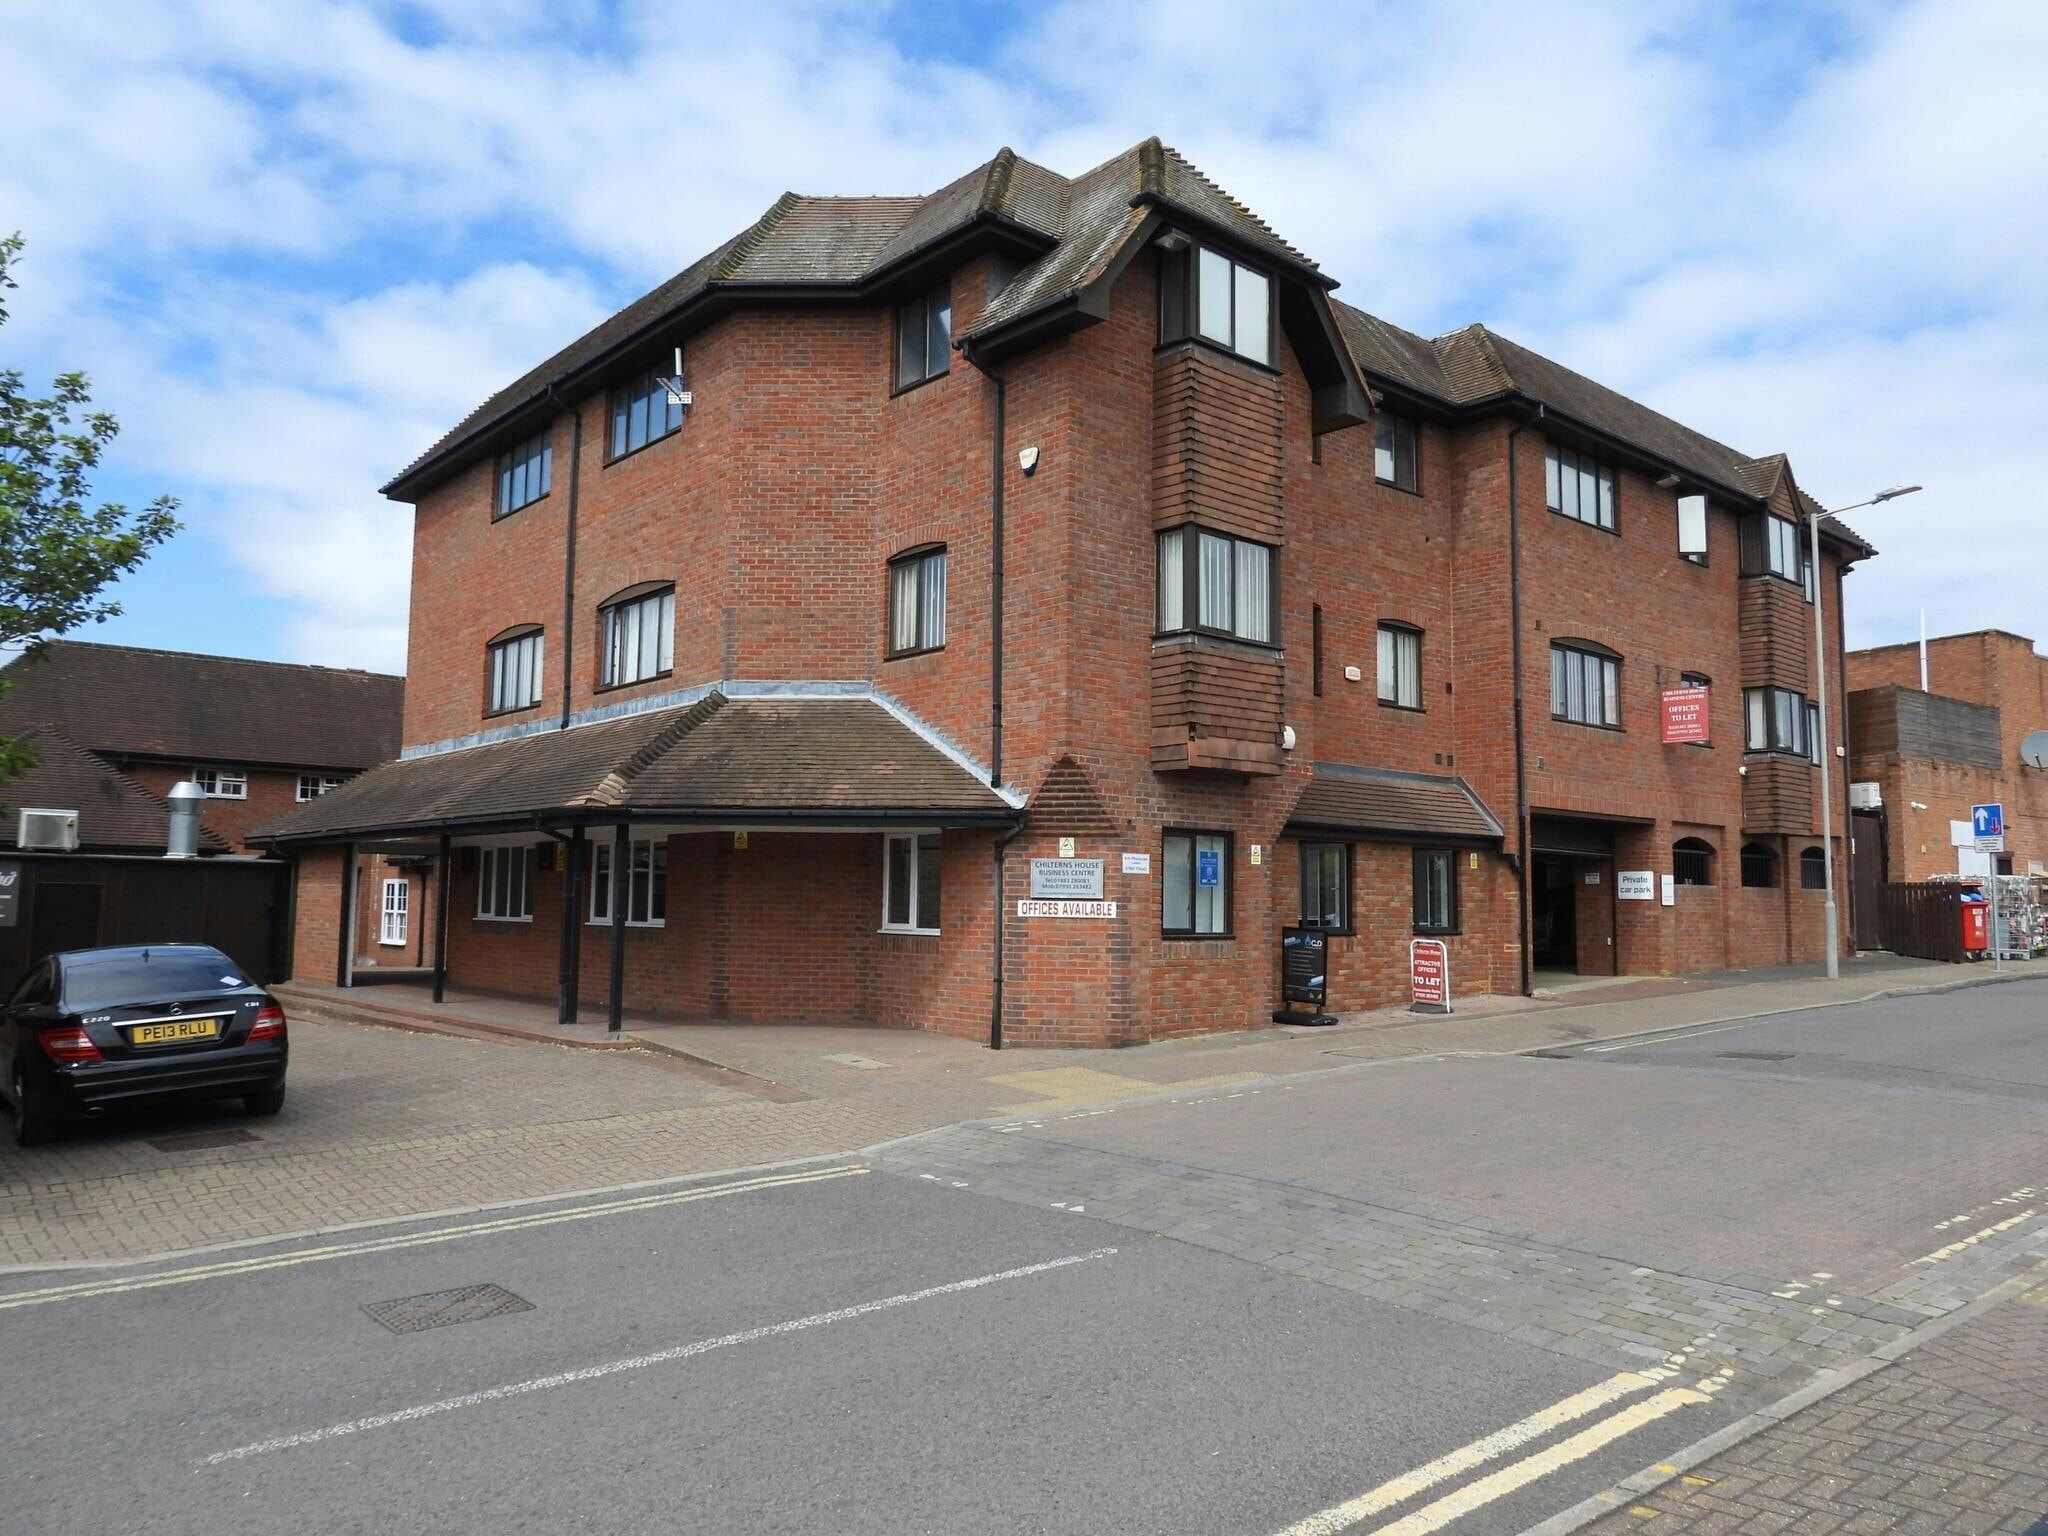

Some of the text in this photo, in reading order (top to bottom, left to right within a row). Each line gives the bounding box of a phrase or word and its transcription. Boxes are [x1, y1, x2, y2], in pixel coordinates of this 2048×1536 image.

[1669, 704, 1699, 712] OFFICES
[1634, 886, 1651, 895] park
[1021, 902, 1112, 916] OFFICES AVAILABLE
[1414, 976, 1441, 986] TO LET
[143, 1022, 207, 1040] PE13 RLU
